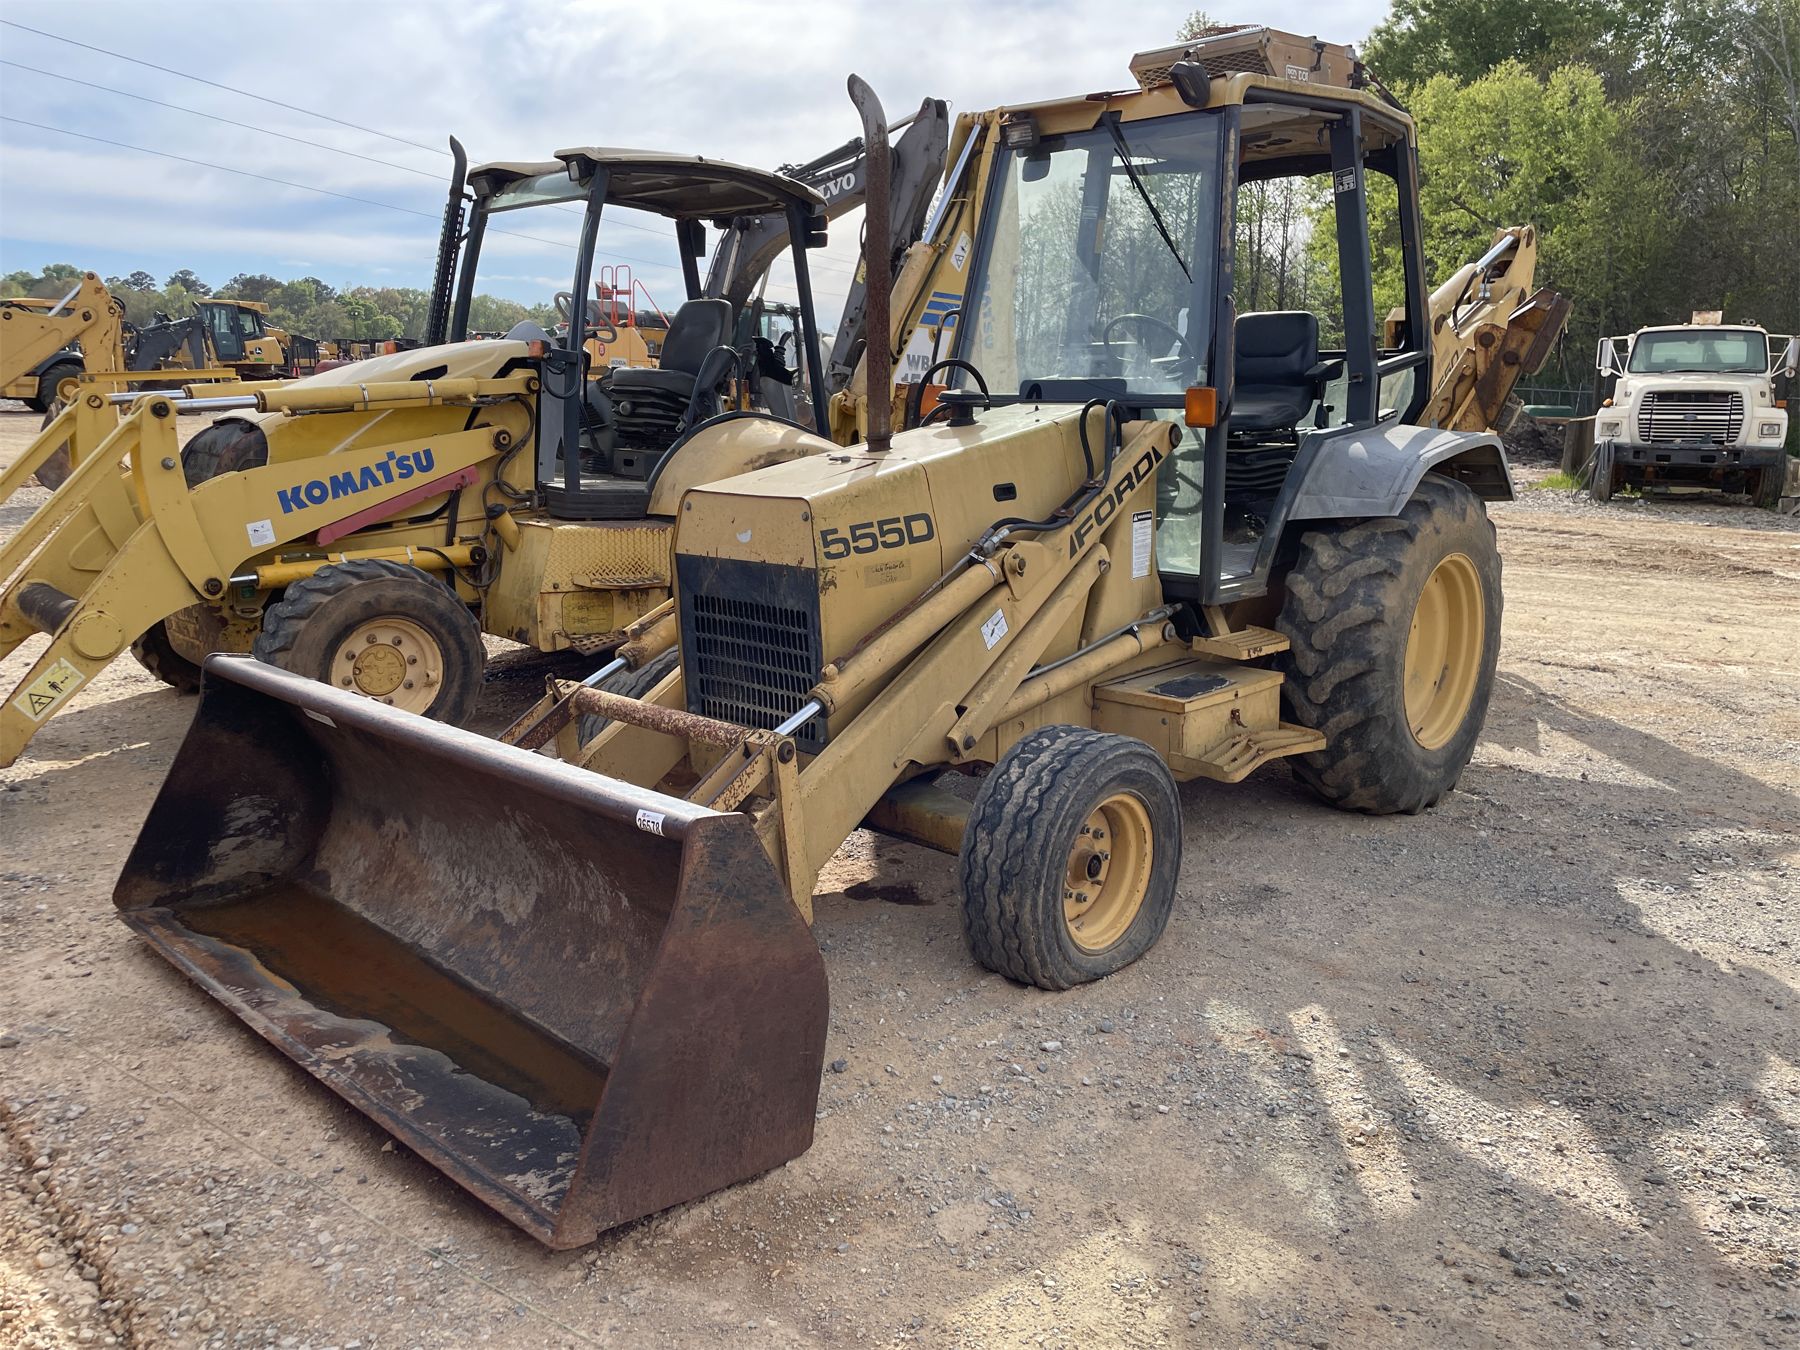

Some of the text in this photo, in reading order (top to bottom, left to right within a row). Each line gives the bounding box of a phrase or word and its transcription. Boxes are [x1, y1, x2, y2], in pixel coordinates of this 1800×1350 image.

[816, 172, 856, 200] LVO
[277, 448, 435, 514] KOMATSU
[1072, 450, 1154, 552] FORD
[820, 513, 935, 560] 555D
